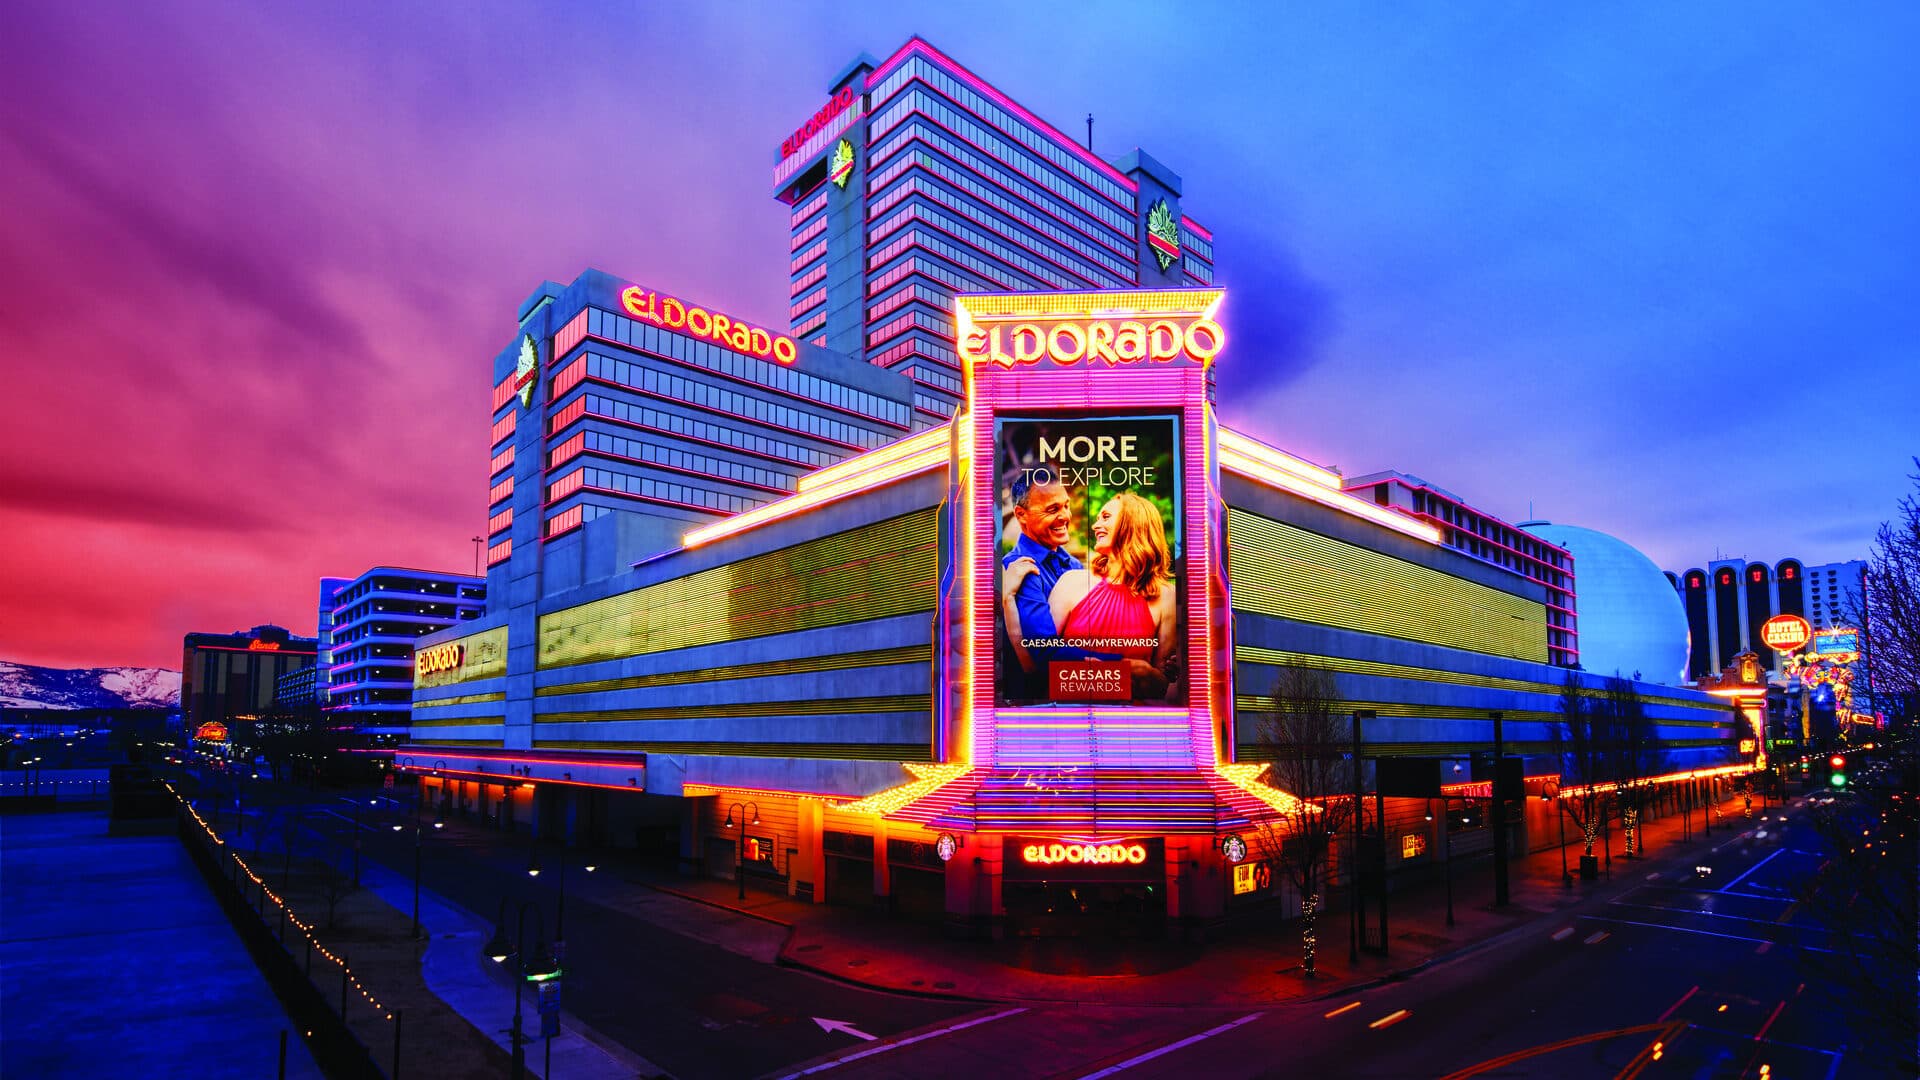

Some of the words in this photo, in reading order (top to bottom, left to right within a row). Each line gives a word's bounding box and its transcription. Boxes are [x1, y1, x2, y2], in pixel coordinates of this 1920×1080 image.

[1039, 436, 1138, 462] MORE
[1021, 468, 1051, 487] TO
[1059, 466, 1155, 486] EXPLORE
[1768, 621, 1803, 633] HOTEL
[1020, 638, 1159, 648] CAESARS.COM/MYREWARDS
[1767, 632, 1805, 644] CASINO
[1059, 669, 1121, 681] CAESARS
